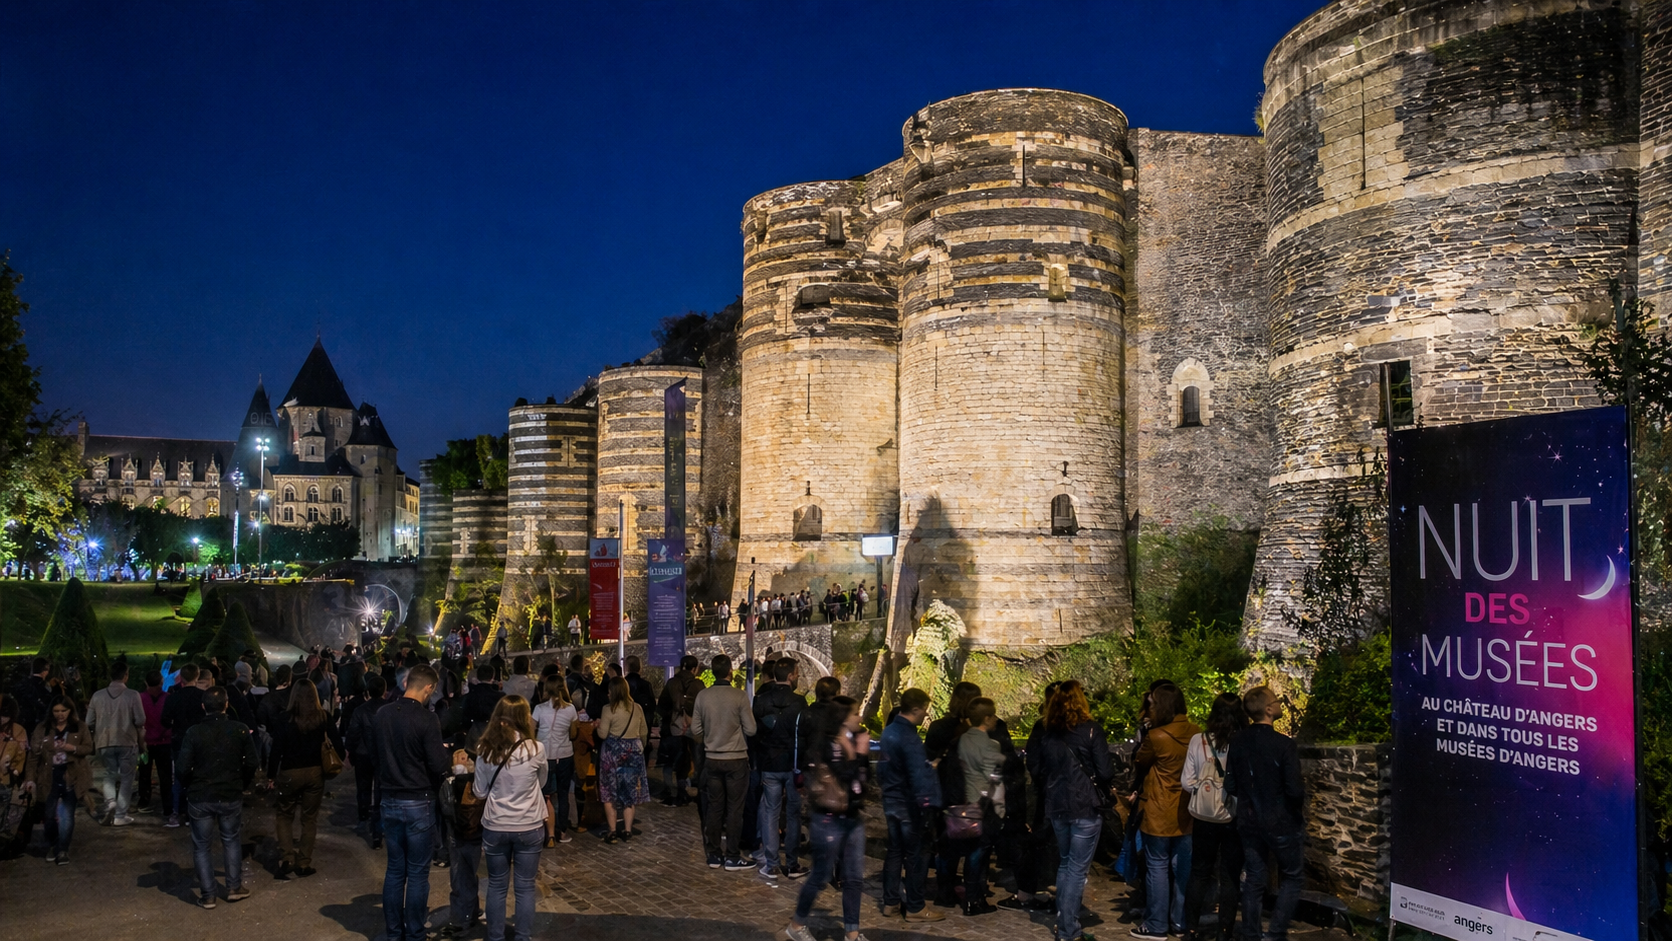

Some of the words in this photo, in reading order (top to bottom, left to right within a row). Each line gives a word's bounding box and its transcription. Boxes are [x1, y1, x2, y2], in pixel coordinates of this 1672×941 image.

[1418, 497, 1592, 582] NUIT
[1465, 592, 1530, 625] DES
[1421, 630, 1598, 692] MUSÉES
[1421, 696, 1440, 711] AU
[1443, 697, 1511, 720] CHÂTEAU
[1515, 707, 1598, 733] D'ANGERS
[1437, 718, 1453, 733] ET
[1457, 721, 1498, 740] DANS
[1501, 727, 1544, 747] TOUS
[1547, 734, 1579, 753] LES
[1436, 737, 1496, 761] MUSÉES
[1499, 748, 1580, 776] D'ANGERS
[1454, 914, 1493, 935] angers
